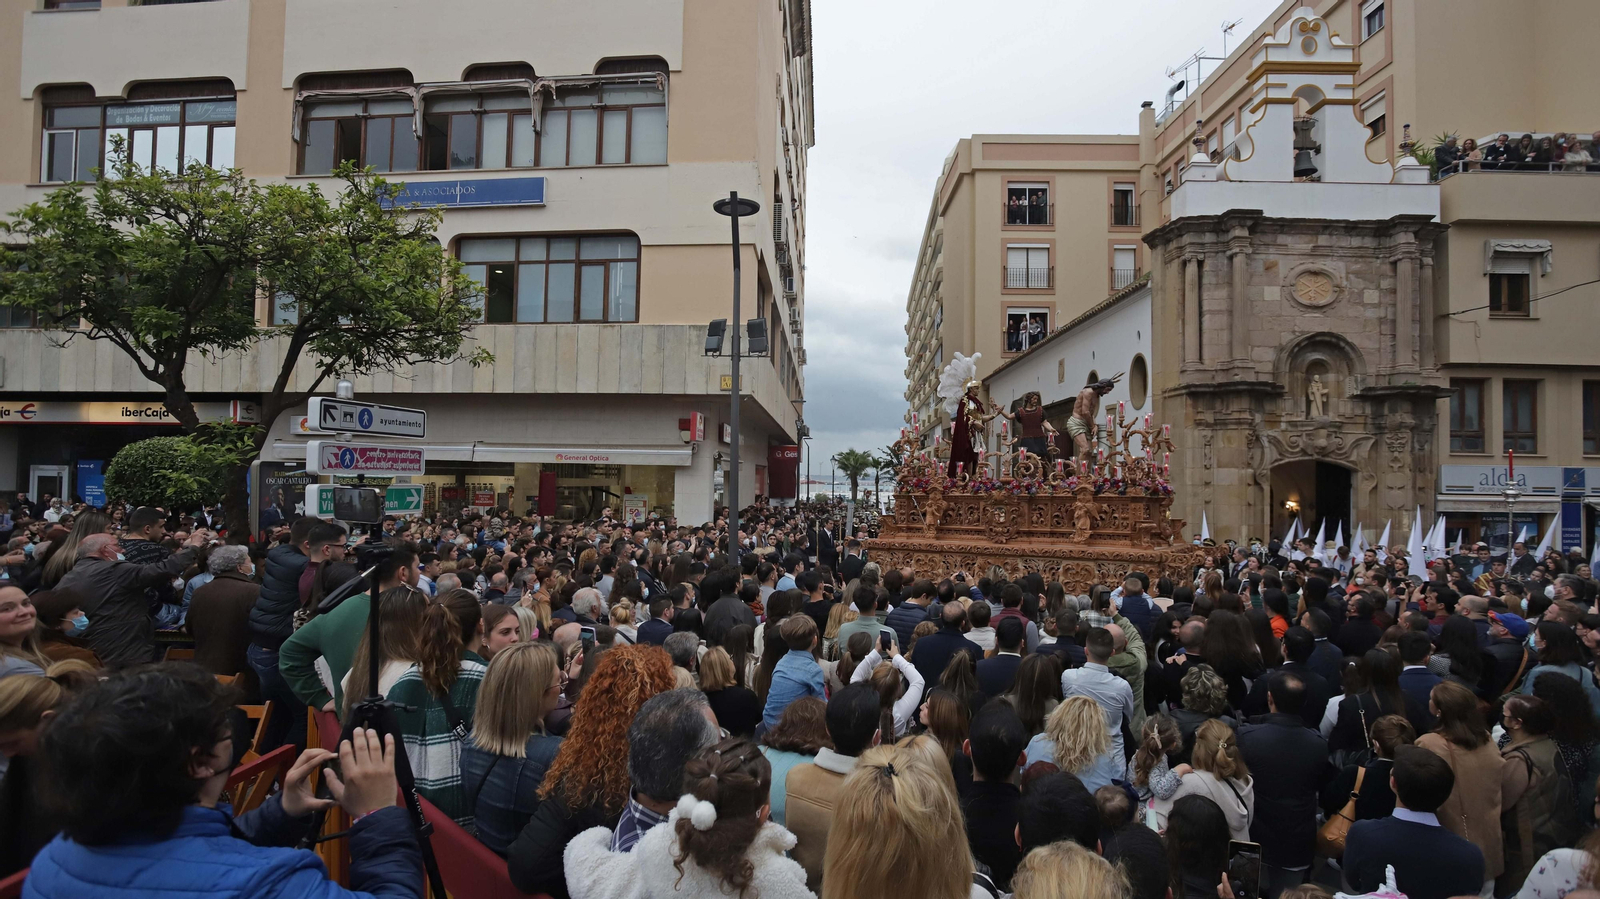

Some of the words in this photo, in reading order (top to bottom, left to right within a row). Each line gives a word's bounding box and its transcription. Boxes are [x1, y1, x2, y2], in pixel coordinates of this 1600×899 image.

[125, 115, 143, 123] Bodas
[414, 189, 420, 197] &
[421, 185, 476, 197] ASOCIADOS
[121, 407, 169, 419] iberCaja
[380, 418, 422, 428] ayuntamiento
